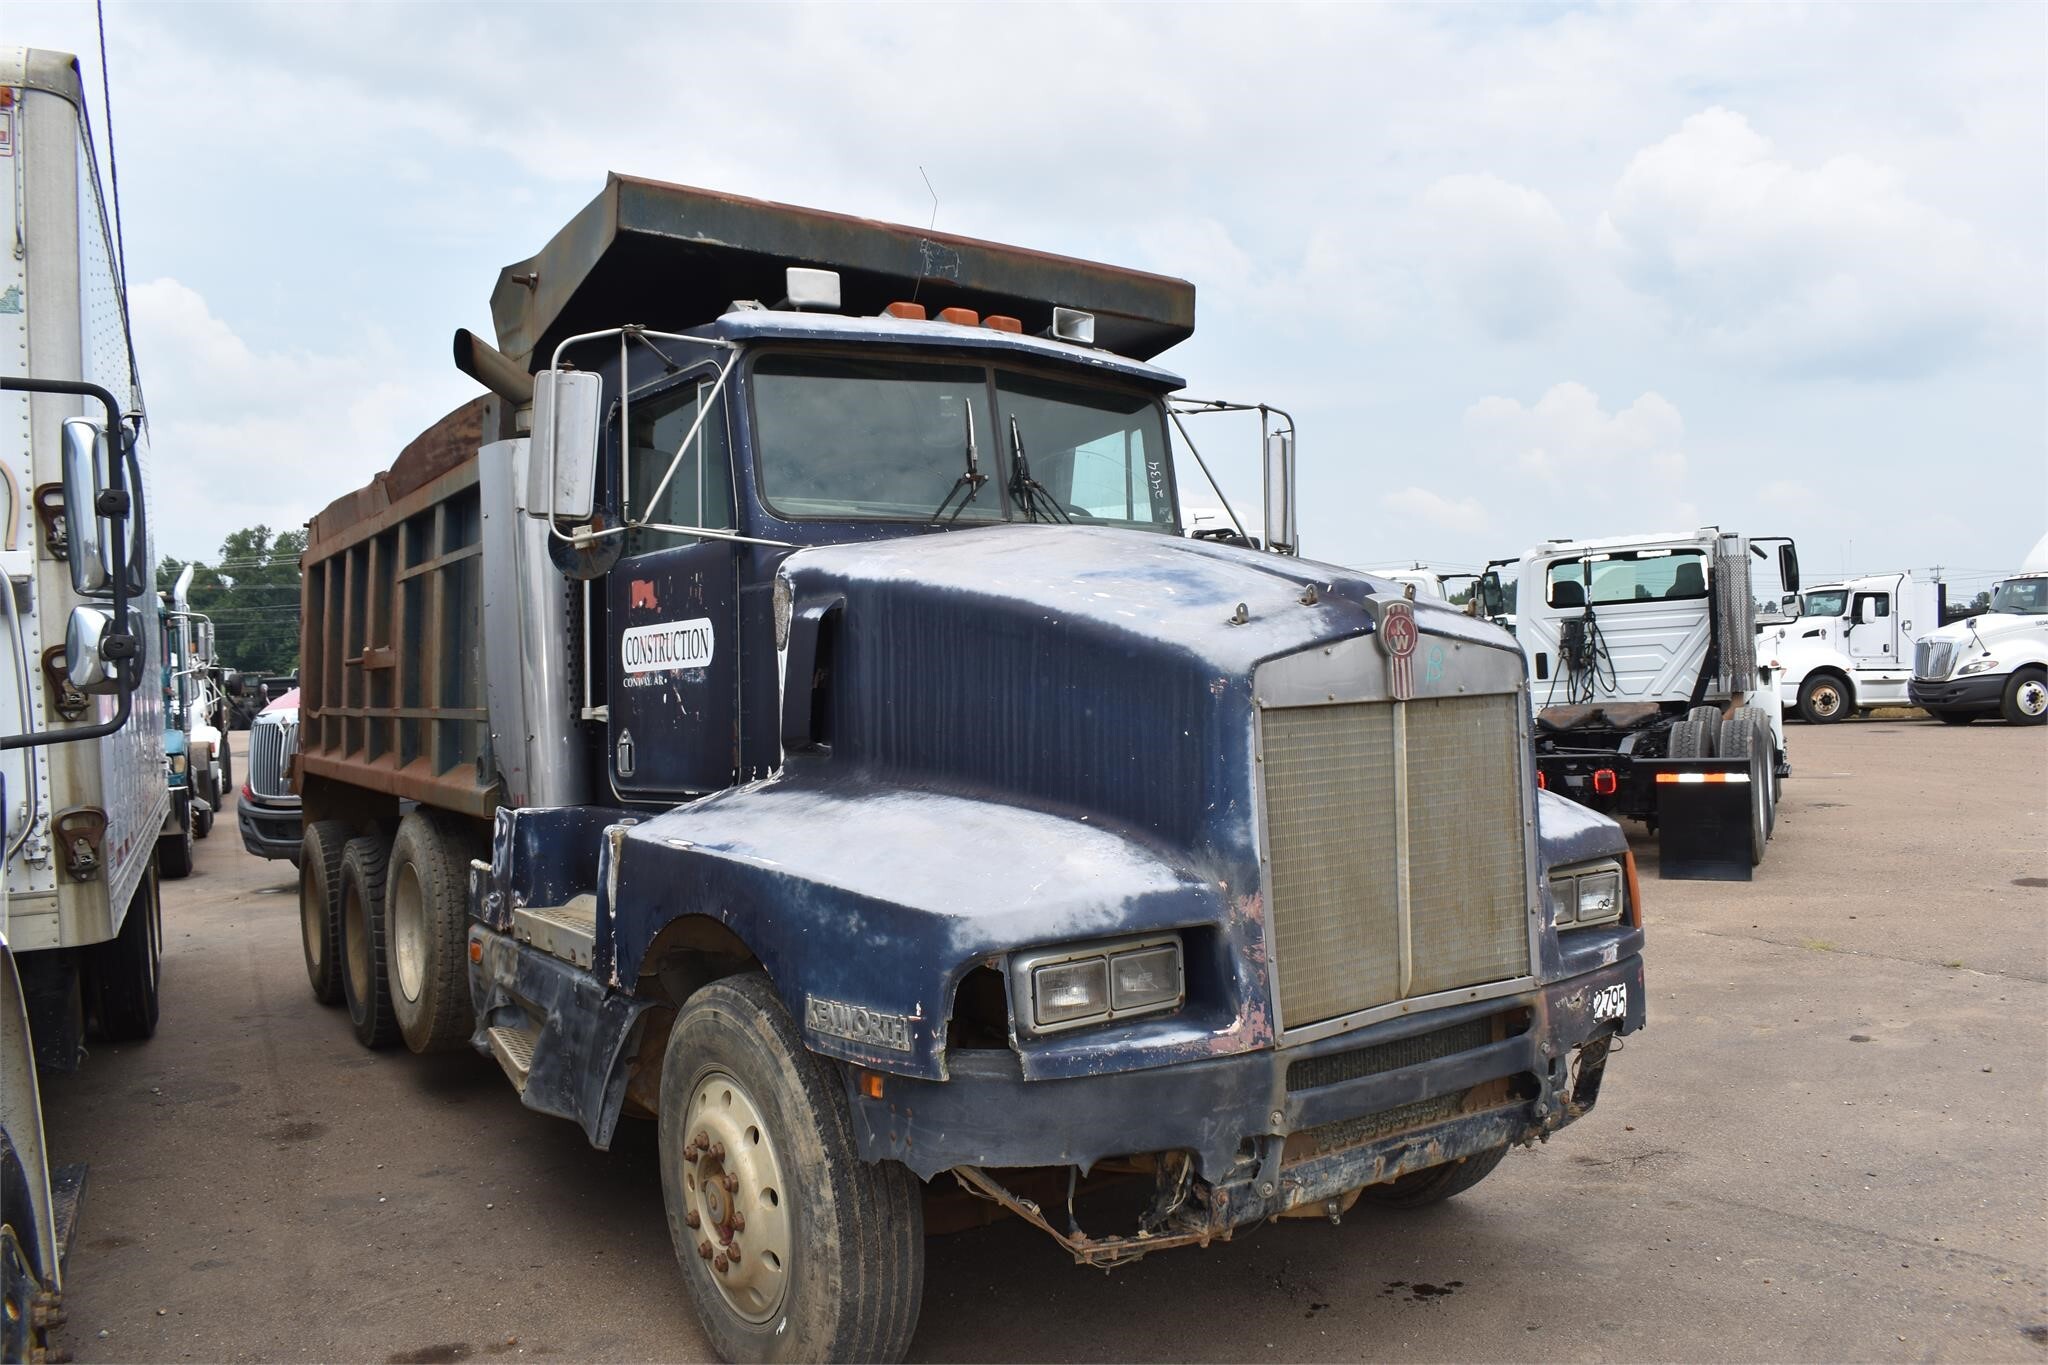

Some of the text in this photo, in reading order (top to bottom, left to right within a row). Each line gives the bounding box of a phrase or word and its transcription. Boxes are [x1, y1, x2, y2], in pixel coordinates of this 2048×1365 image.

[1147, 461, 1164, 499] 2434
[625, 628, 709, 665] CONSTRUCTION
[806, 996, 912, 1051] KENWORTH
